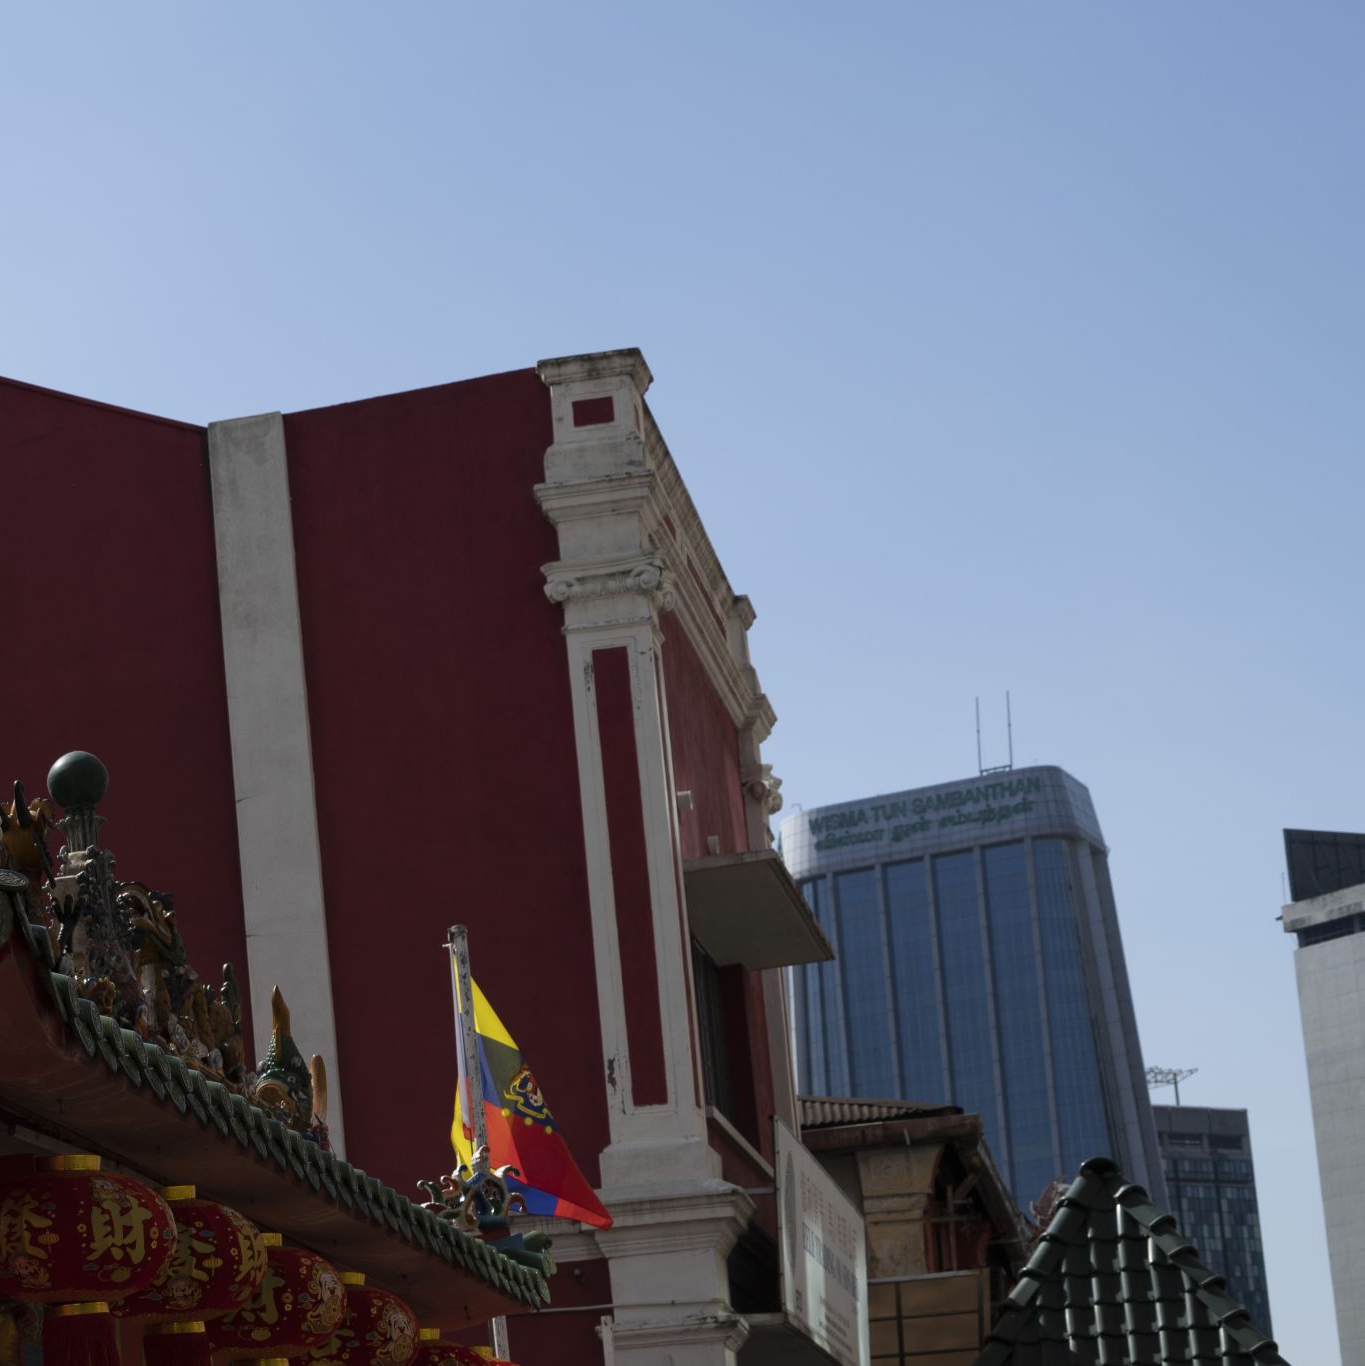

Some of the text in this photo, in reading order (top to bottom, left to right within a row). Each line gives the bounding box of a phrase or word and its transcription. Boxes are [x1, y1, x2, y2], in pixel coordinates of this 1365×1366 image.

[809, 776, 1042, 835] WISMA TUN SAMBANTHAN
